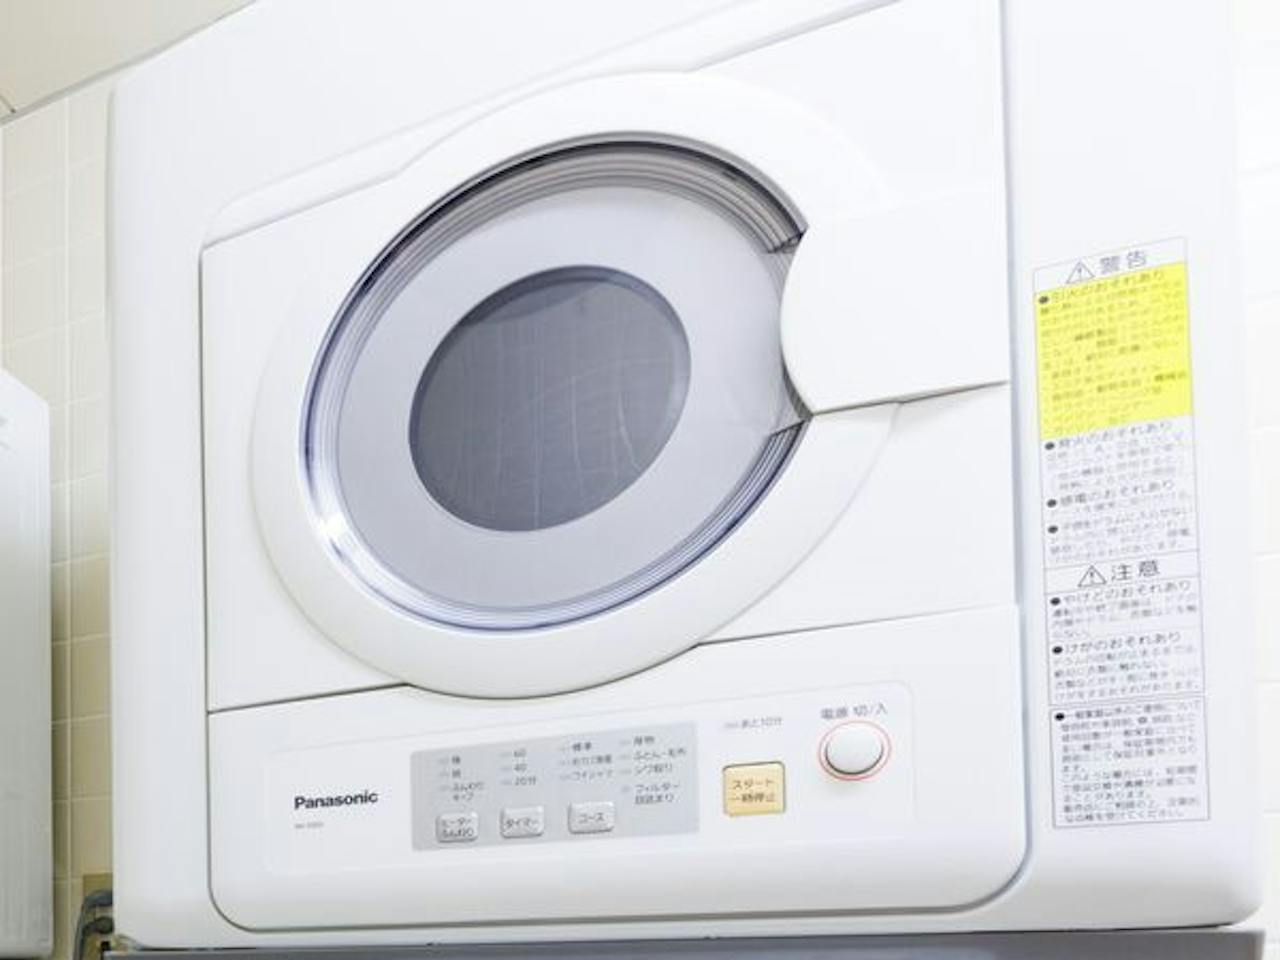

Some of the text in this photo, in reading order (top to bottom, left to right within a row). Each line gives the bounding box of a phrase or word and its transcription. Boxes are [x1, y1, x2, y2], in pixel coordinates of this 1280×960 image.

[1099, 247, 1148, 276] 警告
[1110, 558, 1161, 582] 注意
[1062, 578, 1192, 606] やけどのおそれあり
[1065, 630, 1182, 655] けがのおそれあり
[733, 779, 774, 790] スタート
[294, 789, 379, 809] Panasonic
[579, 812, 605, 823] コース
